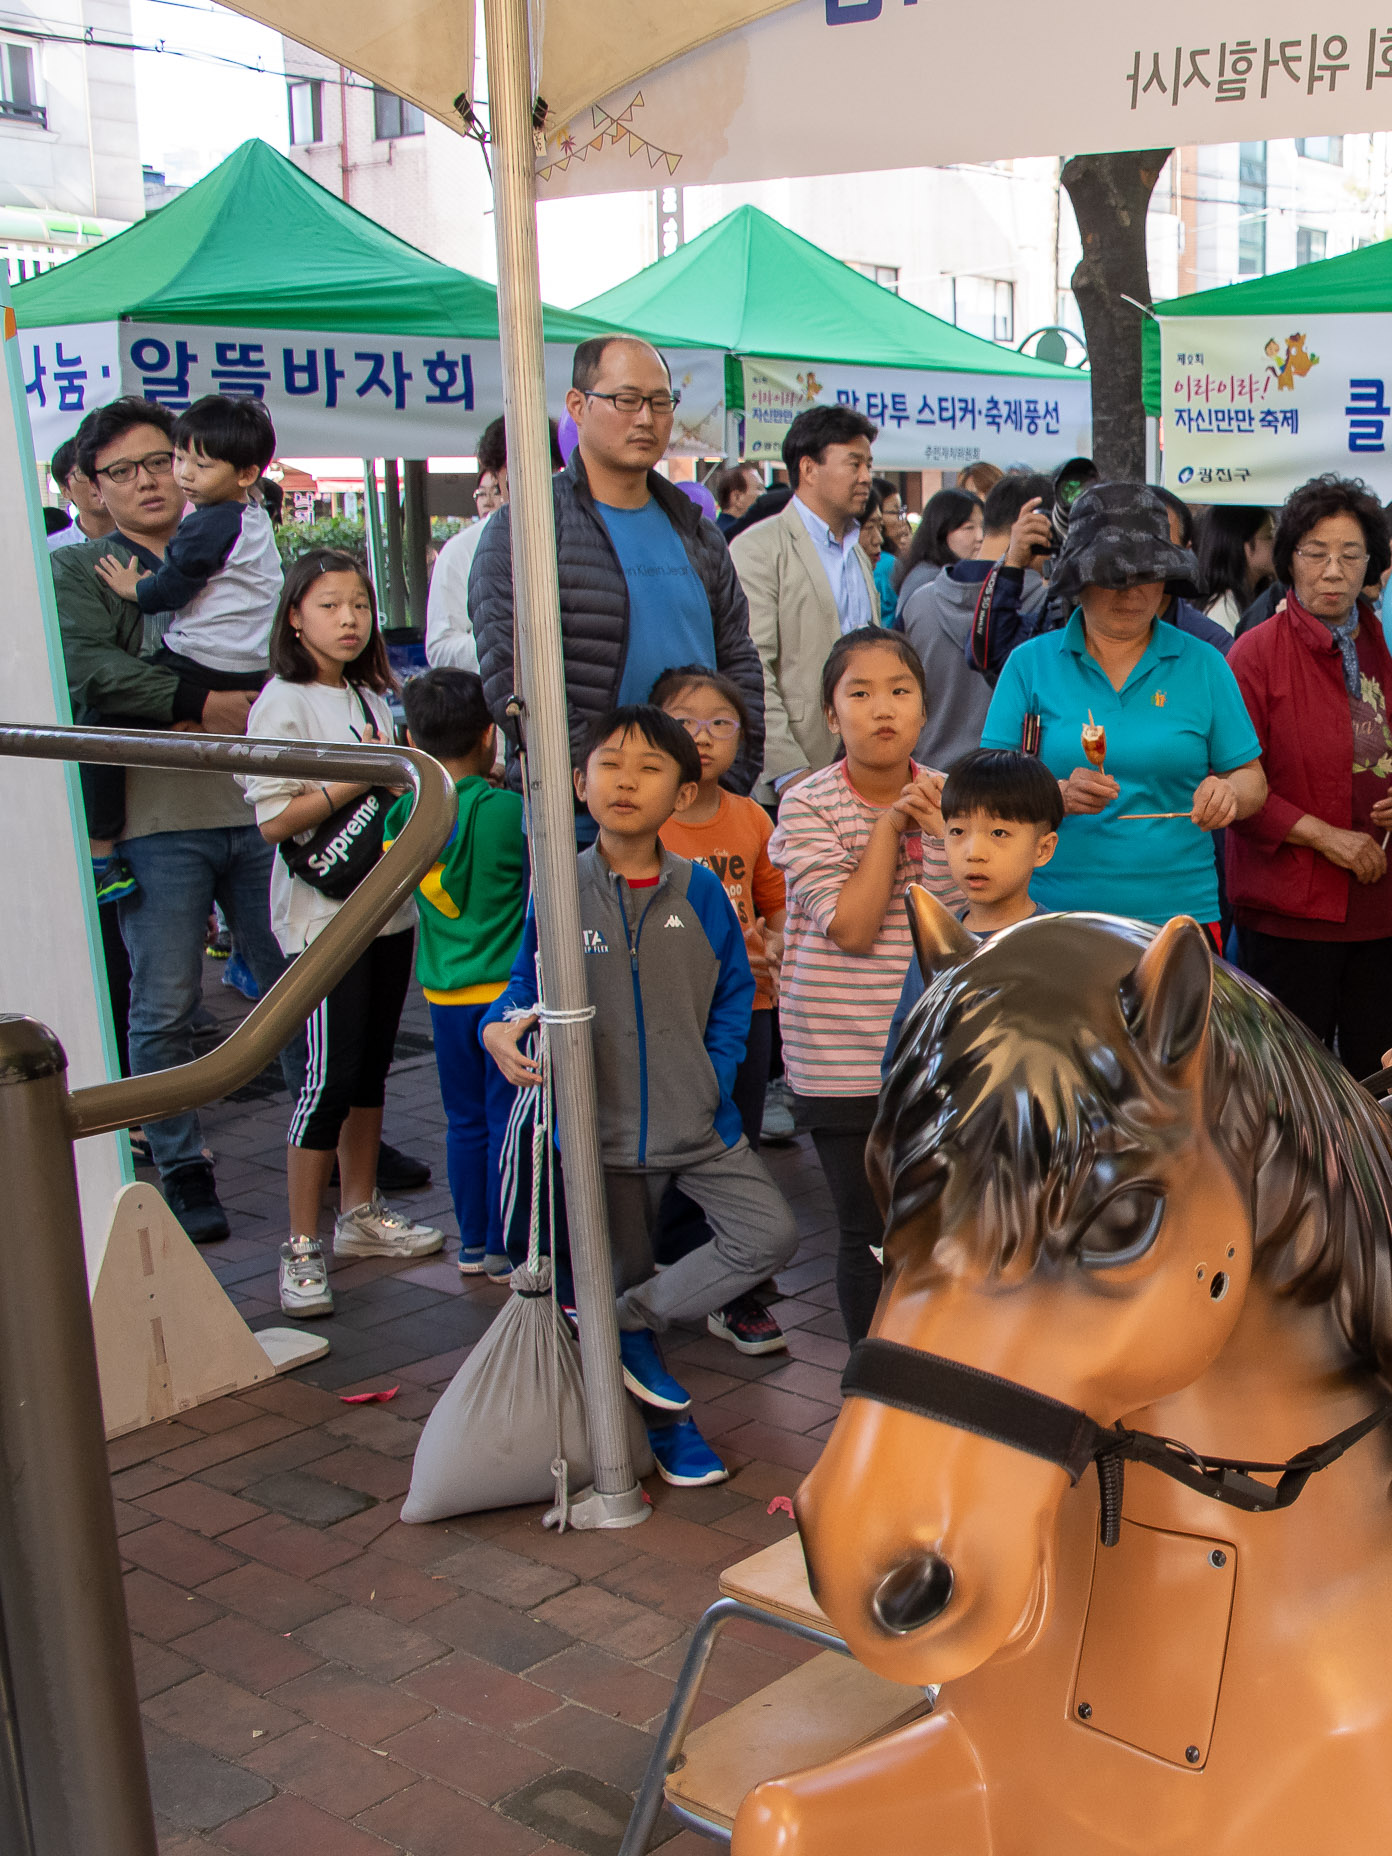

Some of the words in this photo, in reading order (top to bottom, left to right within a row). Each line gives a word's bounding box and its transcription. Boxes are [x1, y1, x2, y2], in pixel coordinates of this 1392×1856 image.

[130, 338, 475, 411] 알뜰바자회
[1174, 374, 1271, 403] 이랴이랴!
[866, 392, 910, 429] 타투
[916, 395, 1061, 436] 스티커·축제풍선
[1174, 408, 1255, 434] 자신만만
[1259, 408, 1299, 434] 축제
[1199, 467, 1252, 483] 광진구
[308, 795, 379, 877] Supreme
